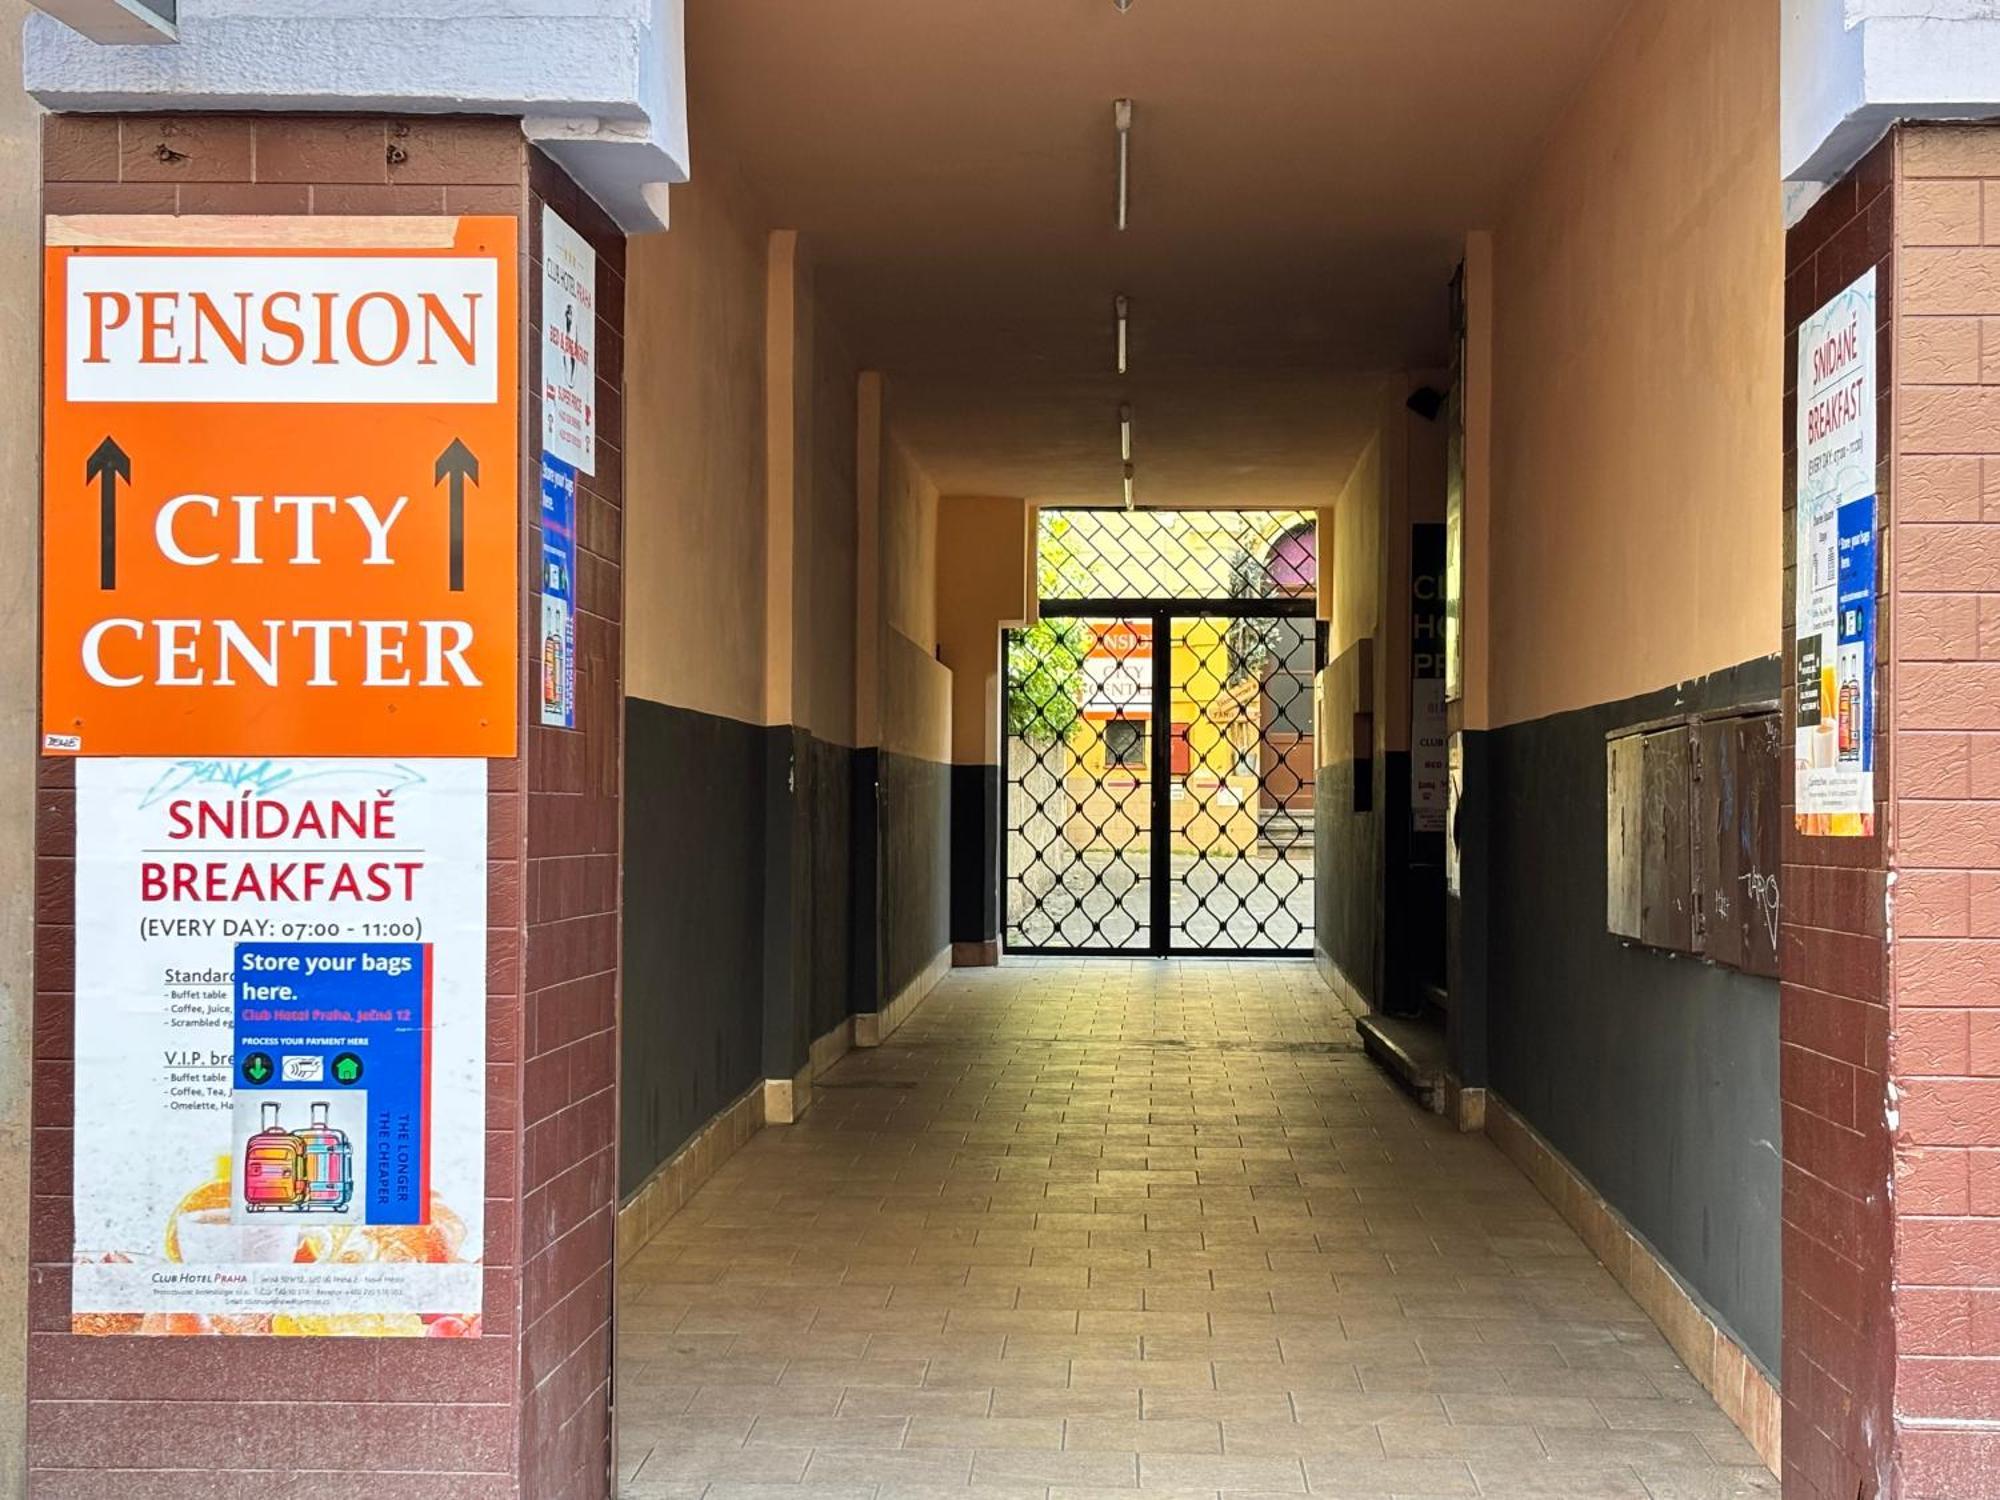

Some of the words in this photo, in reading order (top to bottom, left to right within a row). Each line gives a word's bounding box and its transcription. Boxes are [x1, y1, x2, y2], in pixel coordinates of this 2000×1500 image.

[82, 291, 484, 366] PENSION
[1813, 309, 1857, 386] SNÍDANĚ
[1808, 377, 1864, 446] BREAKFAST
[154, 493, 409, 566] CITY
[81, 618, 483, 687] CENTER
[167, 789, 396, 840] SNÍDANĚ
[141, 862, 424, 902] BREAKFAST
[140, 917, 216, 941] (EVERY
[223, 919, 275, 938] DAY:
[281, 922, 340, 942] 07:00
[362, 917, 423, 941] 11:00)
[242, 952, 300, 971] Store
[305, 956, 356, 976] your
[361, 952, 413, 976] bags
[171, 989, 200, 1000] Buffet
[203, 989, 227, 1000] table
[242, 981, 298, 1001] here.
[171, 1003, 205, 1015] Coffee,
[206, 1003, 233, 1015] Juice,
[242, 1008, 272, 1021] Club
[274, 1008, 310, 1021] Hotel
[396, 1009, 411, 1021] 12
[171, 1017, 221, 1027] Scrambled
[242, 1037, 279, 1046] PROCESS
[280, 1037, 304, 1046] YOUR
[305, 1037, 346, 1046] PAYMENT
[347, 1037, 369, 1046] HERE
[164, 1050, 206, 1065] V.I.P.
[170, 1073, 200, 1082] Buffet
[202, 1072, 227, 1082] table
[170, 1087, 205, 1097] Coffee,
[206, 1087, 227, 1097] Tea,
[170, 1100, 219, 1111] Omelette,
[379, 1110, 390, 1138] THE
[398, 1113, 409, 1140] THE
[378, 1142, 390, 1205] CHEAPER
[397, 1144, 409, 1202] LONGER
[151, 1272, 178, 1284] CLUB
[180, 1273, 213, 1284] HOTEL
[214, 1273, 248, 1283] PRAHA
